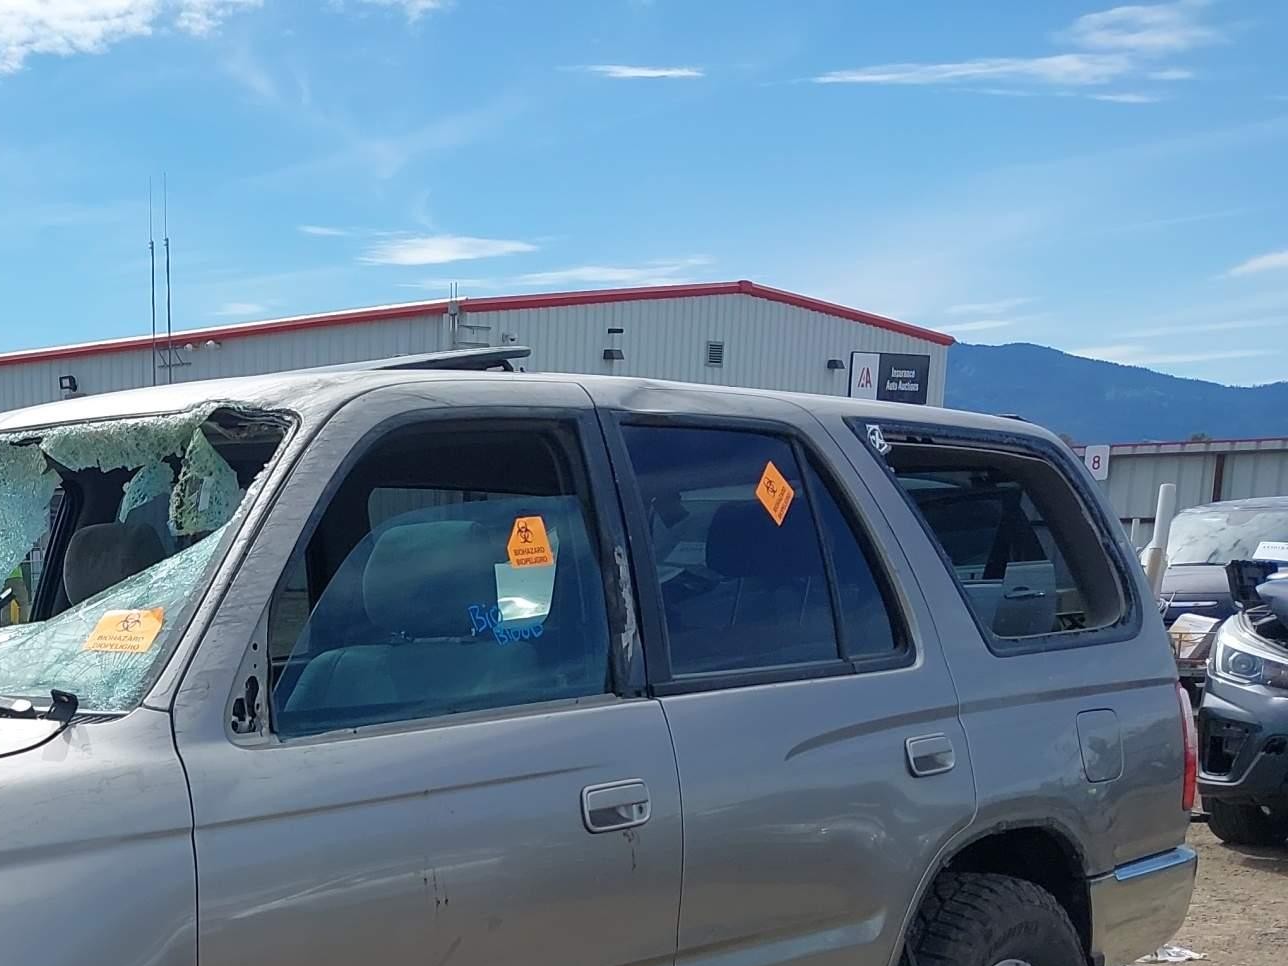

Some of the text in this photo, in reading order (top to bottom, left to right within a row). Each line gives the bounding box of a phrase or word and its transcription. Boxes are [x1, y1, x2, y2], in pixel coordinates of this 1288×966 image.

[886, 380, 918, 391] Auto Auctions
[1091, 455, 1101, 471] 8
[514, 546, 545, 555] BIOHAZARD
